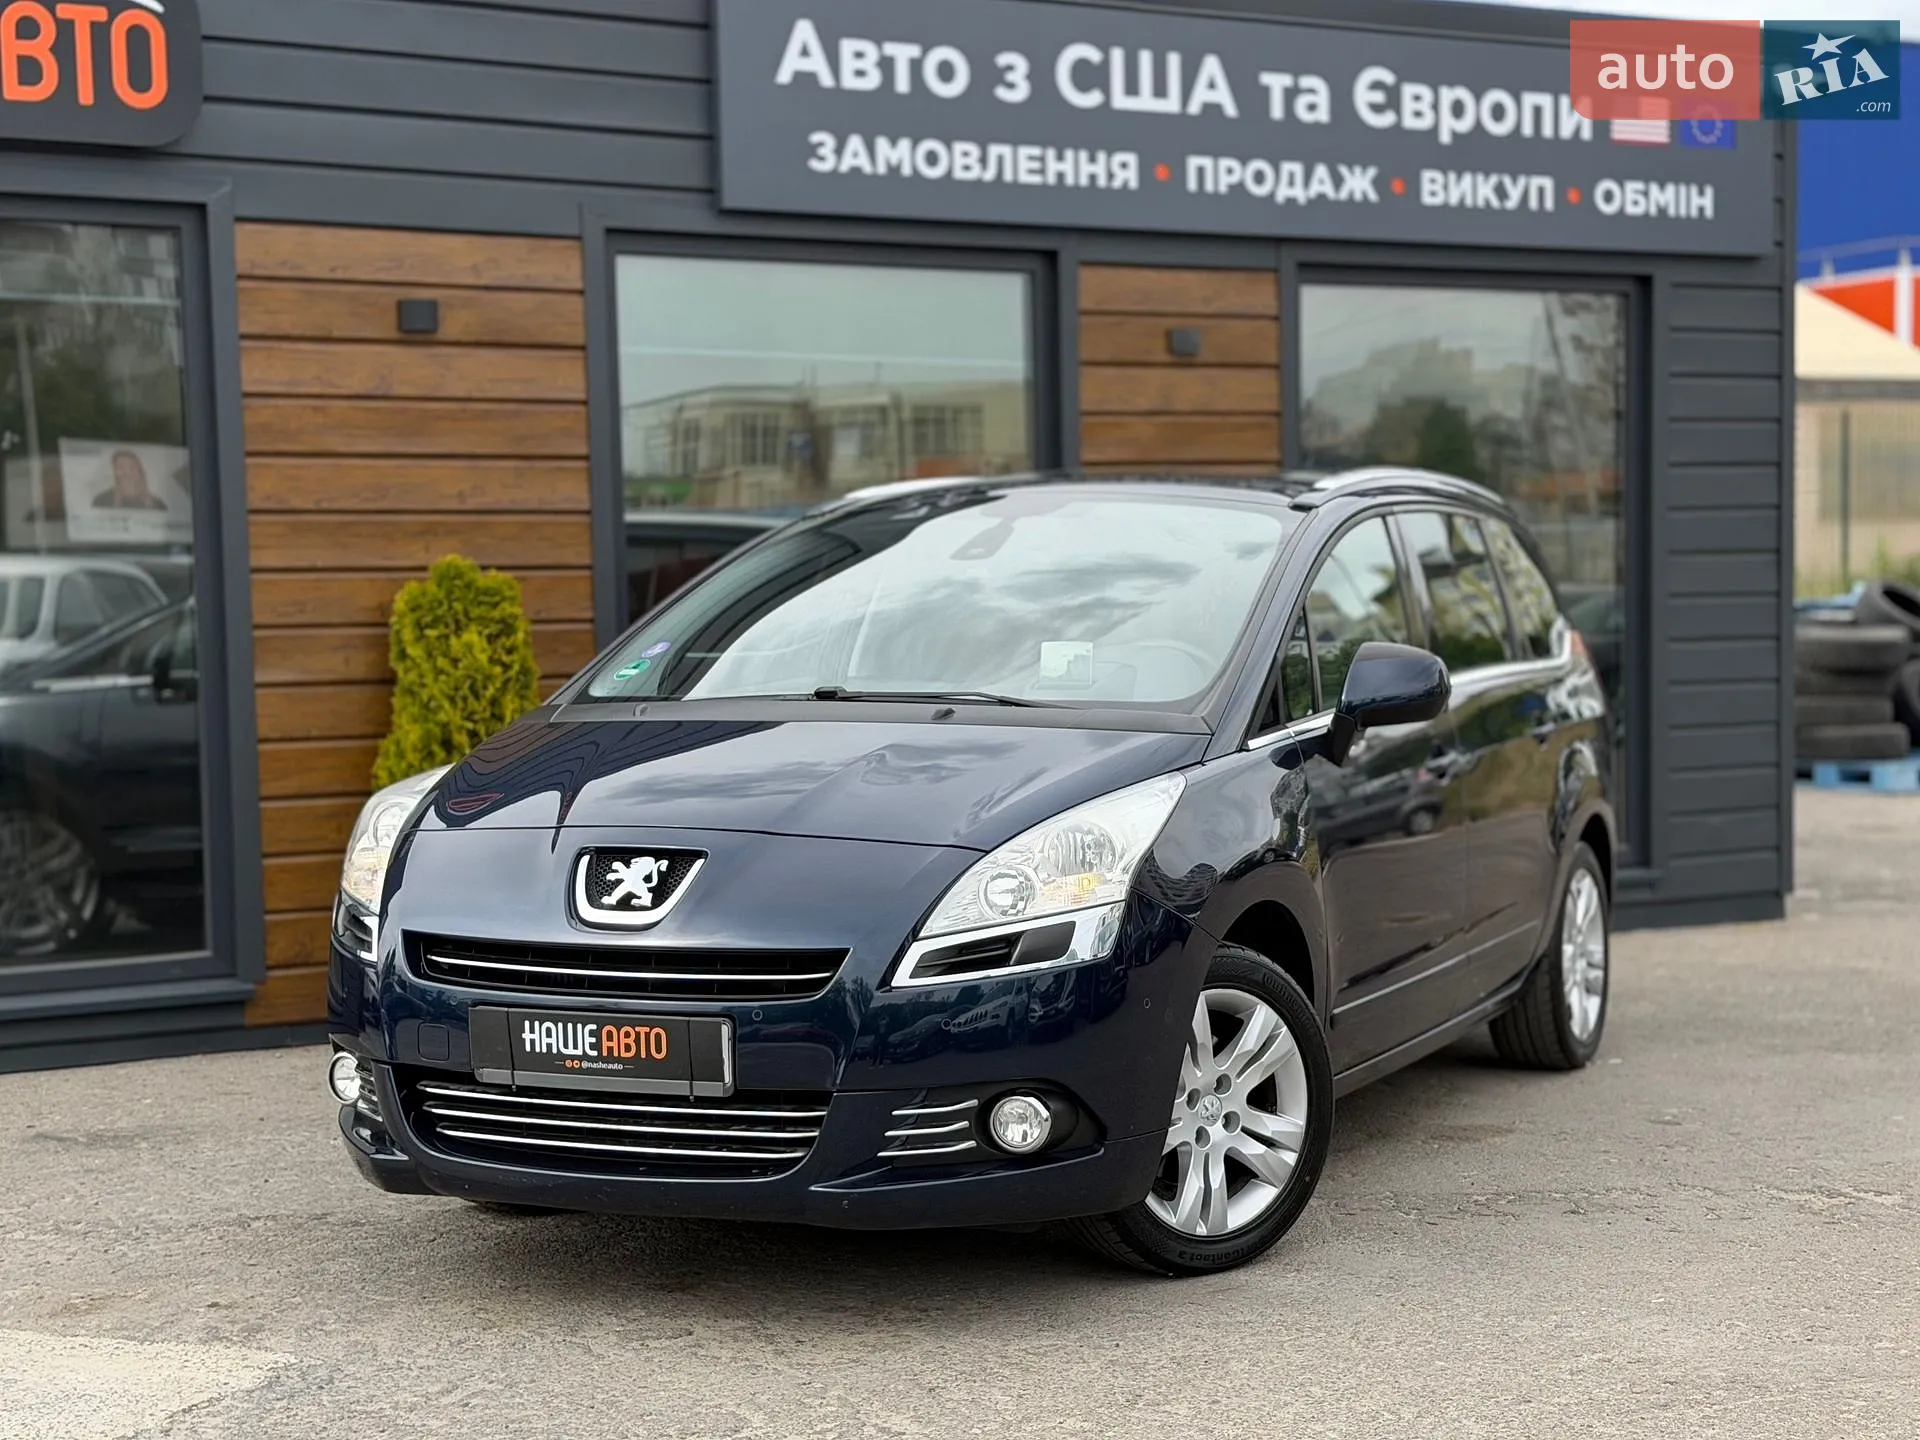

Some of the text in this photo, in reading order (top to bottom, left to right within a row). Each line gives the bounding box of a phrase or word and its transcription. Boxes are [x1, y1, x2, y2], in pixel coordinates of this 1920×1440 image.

[774, 18, 1593, 146] Авто з США та Європи
[807, 130, 1715, 220] ЗАМОВЛЕННЯ ПРОДАЖ ВИКУП ОБМІН
[521, 1019, 668, 1060] НАШЕ АВТО
[581, 1060, 624, 1070] @nasheauto
